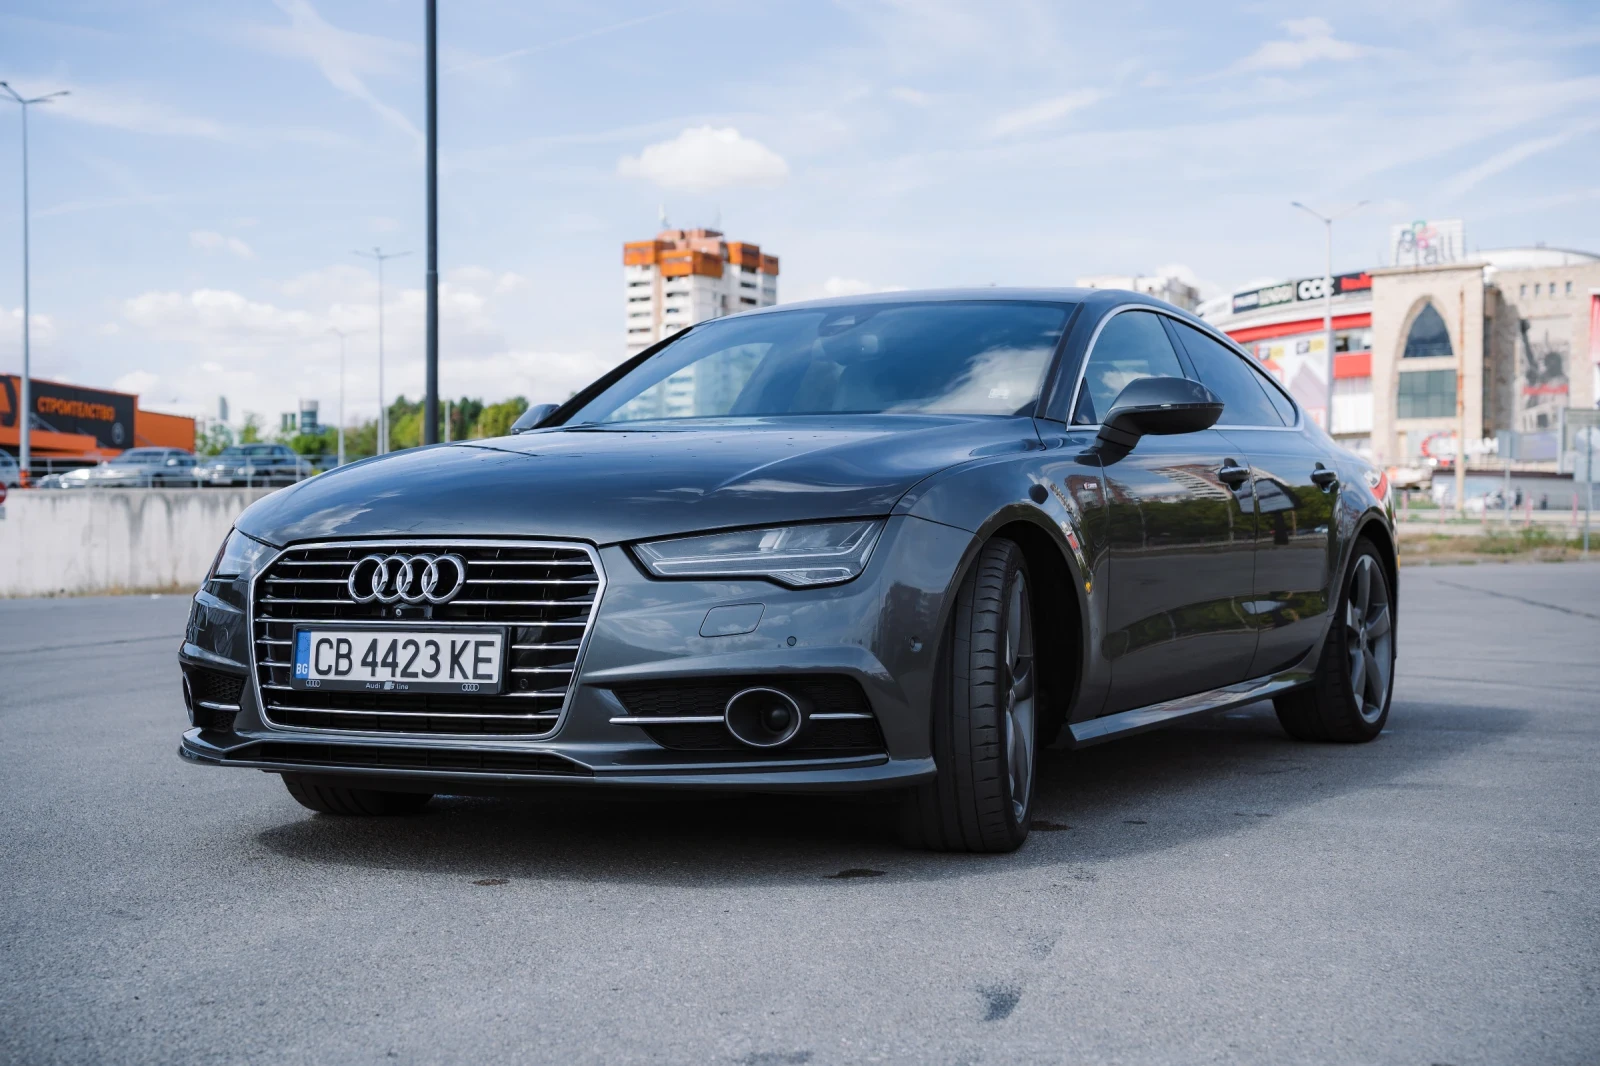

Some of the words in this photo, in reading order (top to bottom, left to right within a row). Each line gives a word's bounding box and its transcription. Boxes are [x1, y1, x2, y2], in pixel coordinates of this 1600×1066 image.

[314, 637, 353, 677] CB
[360, 638, 441, 679] 4423
[448, 639, 496, 681] KE
[296, 663, 308, 675] BG
[365, 682, 381, 690] Audi
